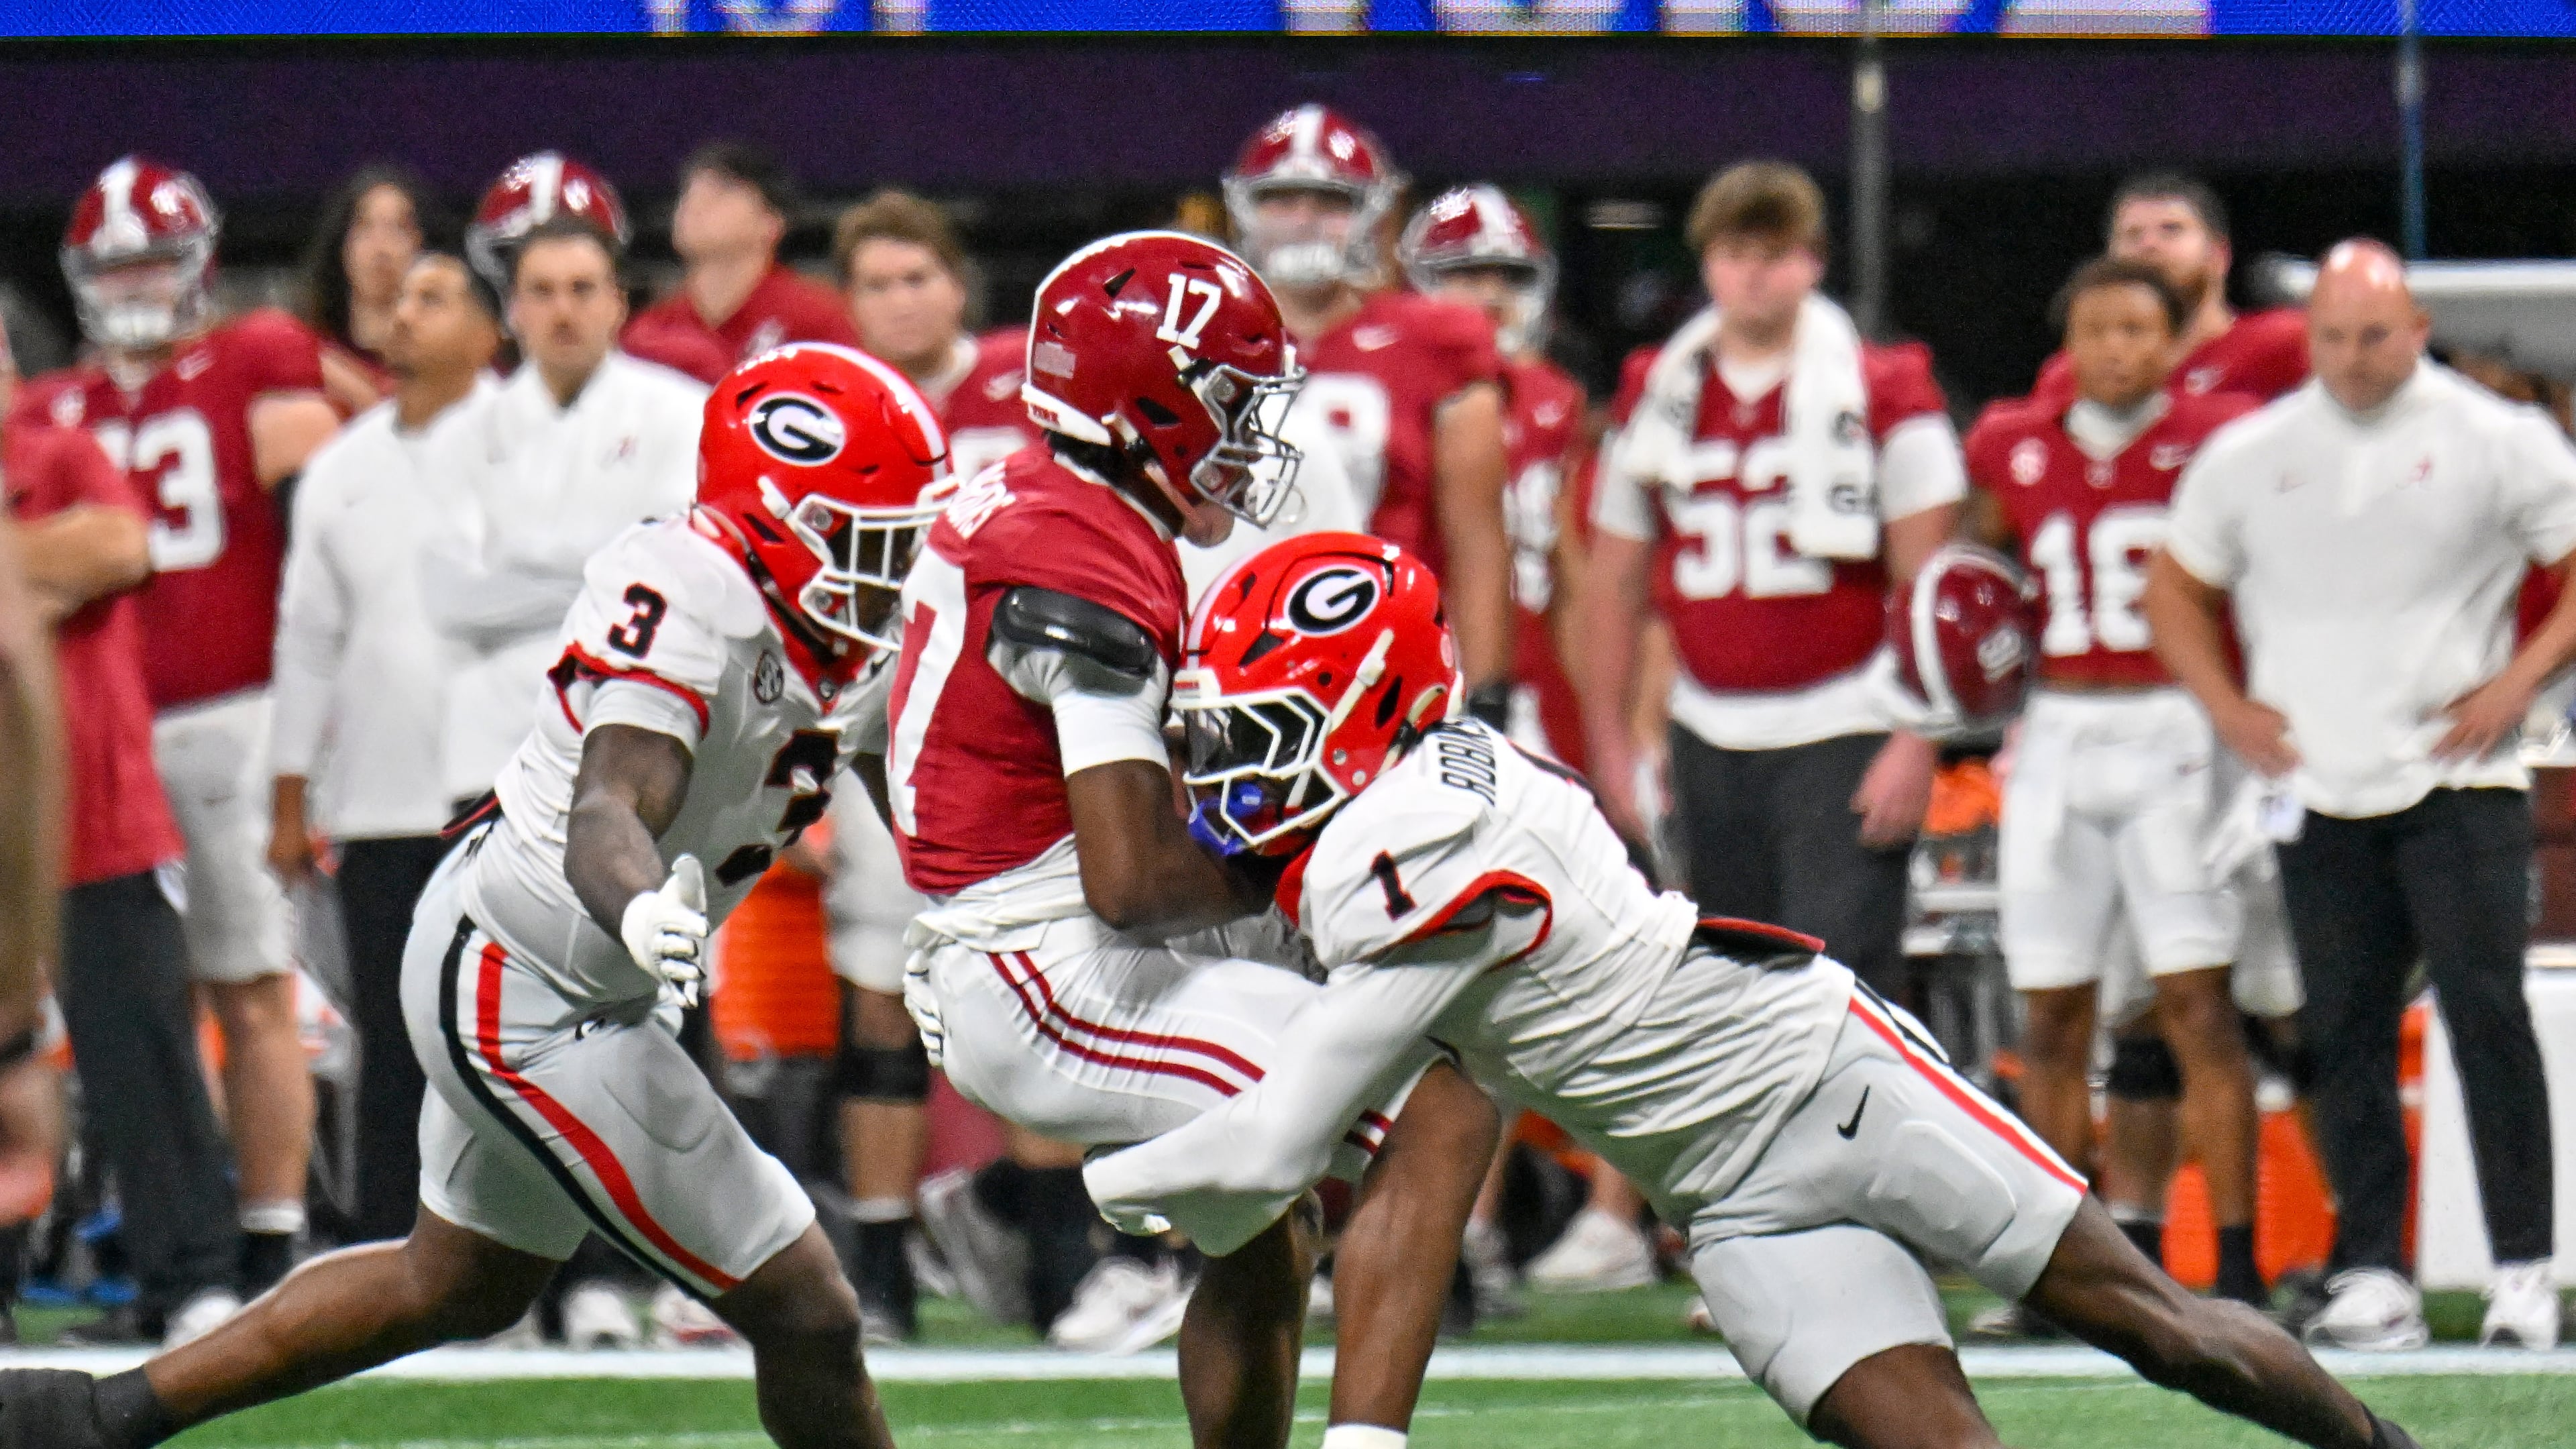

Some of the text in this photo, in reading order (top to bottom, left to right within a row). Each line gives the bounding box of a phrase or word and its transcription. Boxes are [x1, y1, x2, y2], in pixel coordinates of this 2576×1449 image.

[1155, 272, 1222, 350] 17
[750, 394, 843, 463] G
[607, 582, 667, 659] 3
[1286, 567, 1377, 635] G
[885, 545, 967, 837] 7
[1371, 849, 1417, 922] 1
